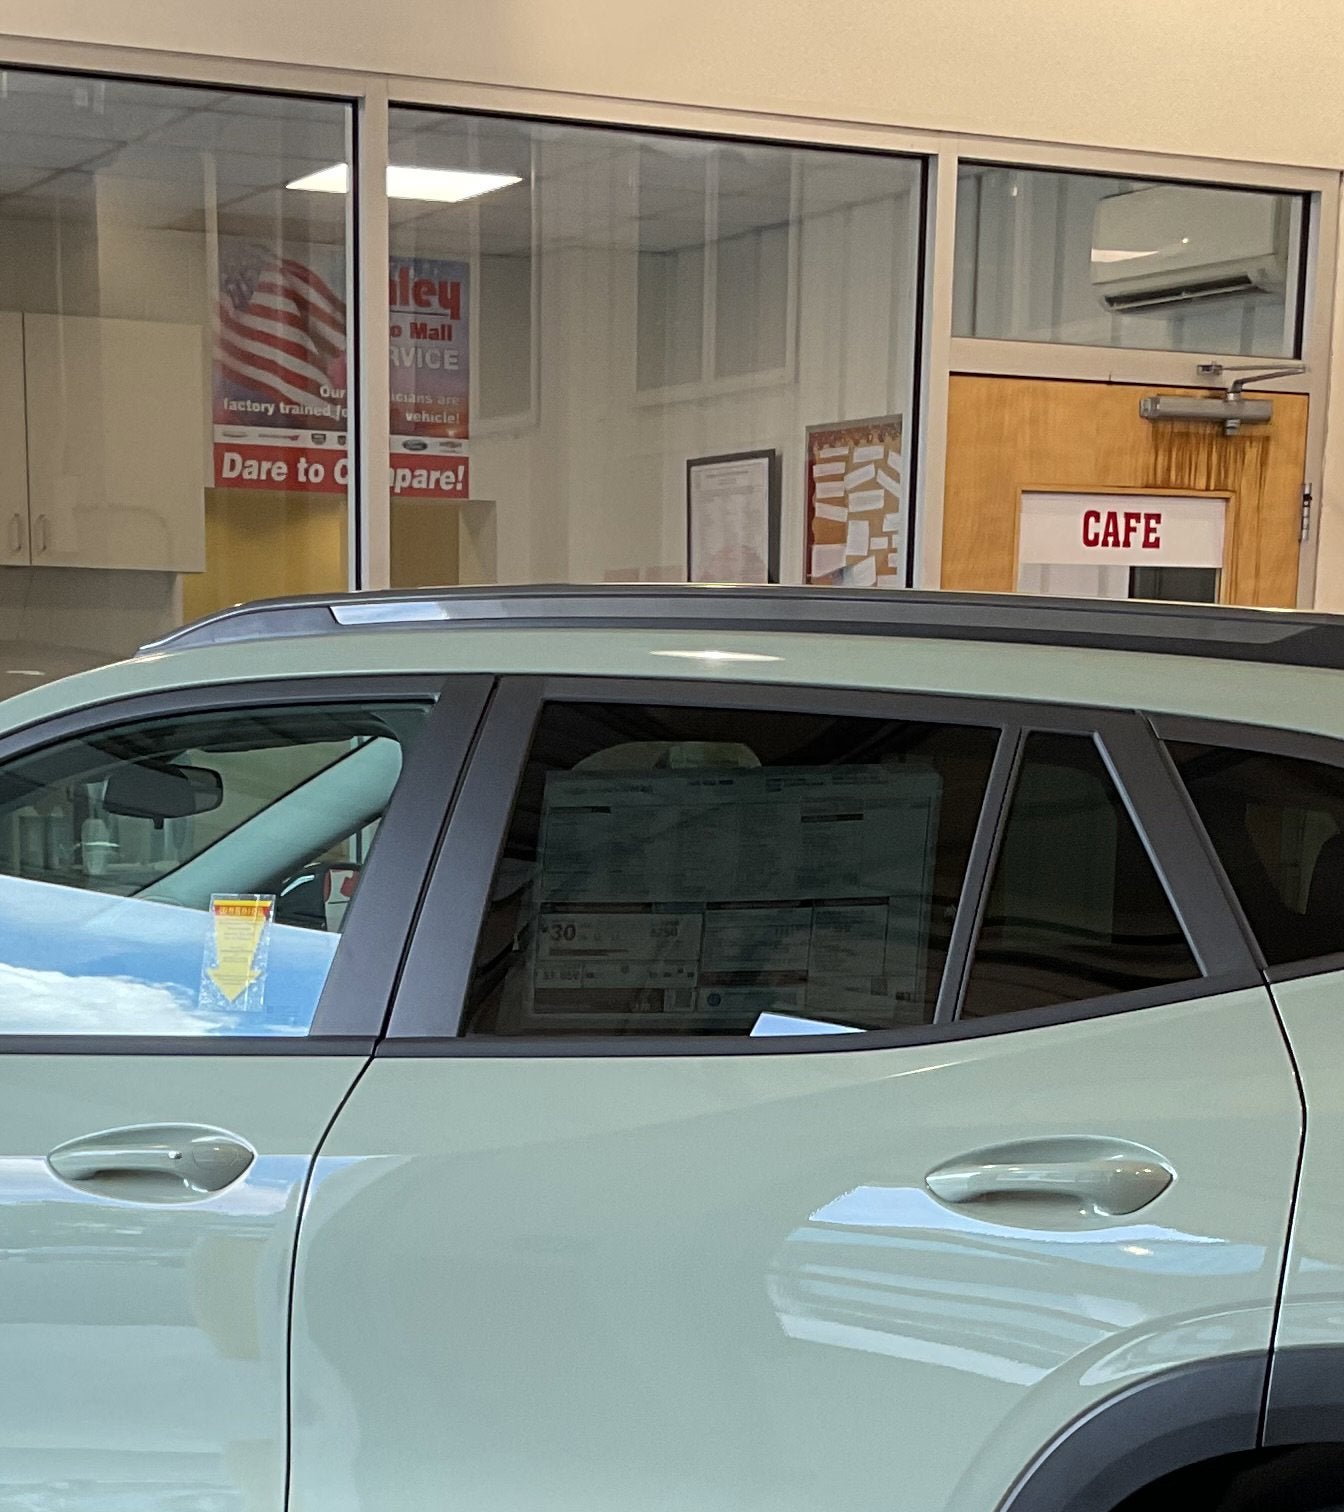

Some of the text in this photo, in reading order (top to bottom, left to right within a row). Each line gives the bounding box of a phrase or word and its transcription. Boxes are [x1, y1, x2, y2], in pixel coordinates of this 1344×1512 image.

[389, 266, 461, 320] ley
[410, 322, 452, 341] Mall
[390, 346, 459, 370] RVICE
[319, 383, 346, 399] Our
[224, 399, 274, 417] factory
[279, 402, 331, 418] trained
[405, 411, 460, 424] vehicle!
[222, 453, 287, 479] Dare
[297, 457, 325, 483] to
[1083, 510, 1161, 549] CAFE
[550, 924, 577, 941] 30
